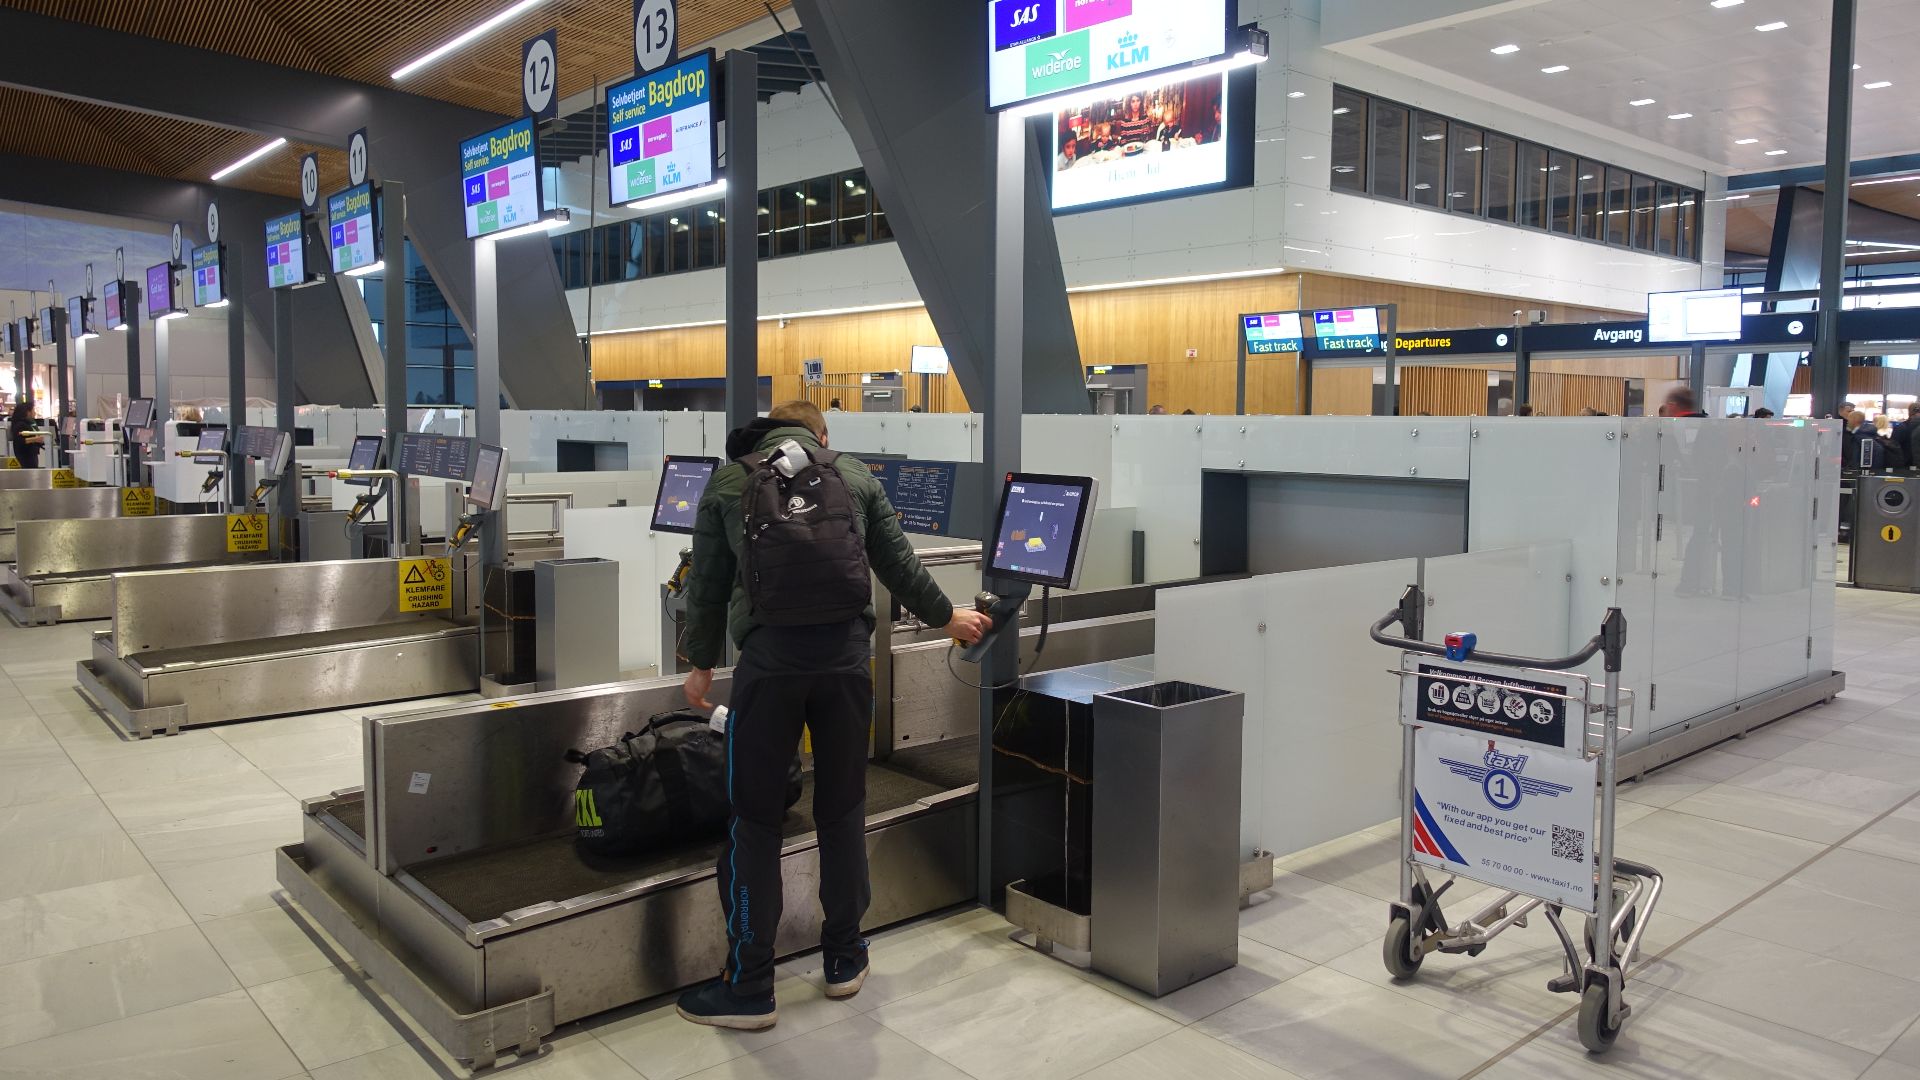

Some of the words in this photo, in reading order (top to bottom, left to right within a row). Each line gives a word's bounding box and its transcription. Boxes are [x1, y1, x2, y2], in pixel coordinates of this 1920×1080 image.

[1010, 4, 1040, 28] SAS
[642, 8, 668, 54] 13
[1032, 55, 1082, 79] widerøe
[1107, 45, 1150, 70] KLM
[530, 55, 550, 95] 12
[612, 87, 646, 108] Selvbetjent
[648, 67, 706, 106] Bagdrop
[612, 110, 624, 124] Self
[625, 104, 646, 119] service
[490, 128, 531, 160] Bagdrop
[620, 138, 632, 152] SAS
[352, 146, 364, 175] 11
[304, 169, 315, 194] 10
[470, 184, 480, 196] SAS
[662, 172, 681, 186] KLM
[346, 190, 370, 214] Bagdrop
[211, 214, 215, 232] 9
[1254, 341, 1272, 352] Fast
[1274, 340, 1298, 352] track
[1324, 338, 1346, 349] Fast
[1347, 336, 1374, 348] track
[1396, 337, 1450, 351] Departures
[1594, 328, 1642, 343] Avgang
[406, 584, 446, 593] KLEMFARE
[1484, 750, 1528, 773] taxi
[1495, 778, 1508, 799] 1
[1444, 814, 1466, 826] fixed
[1466, 820, 1482, 831] and
[1484, 825, 1503, 837] best
[1460, 808, 1476, 818] our
[1476, 812, 1492, 823] app
[1495, 818, 1512, 828] you
[1513, 822, 1528, 832] get
[1530, 827, 1546, 836] our
[1482, 858, 1490, 866] 55
[1492, 861, 1501, 870] 70
[1502, 864, 1512, 872] 00
[1514, 867, 1524, 876] 00
[1530, 872, 1583, 893] www.taxi1.no
